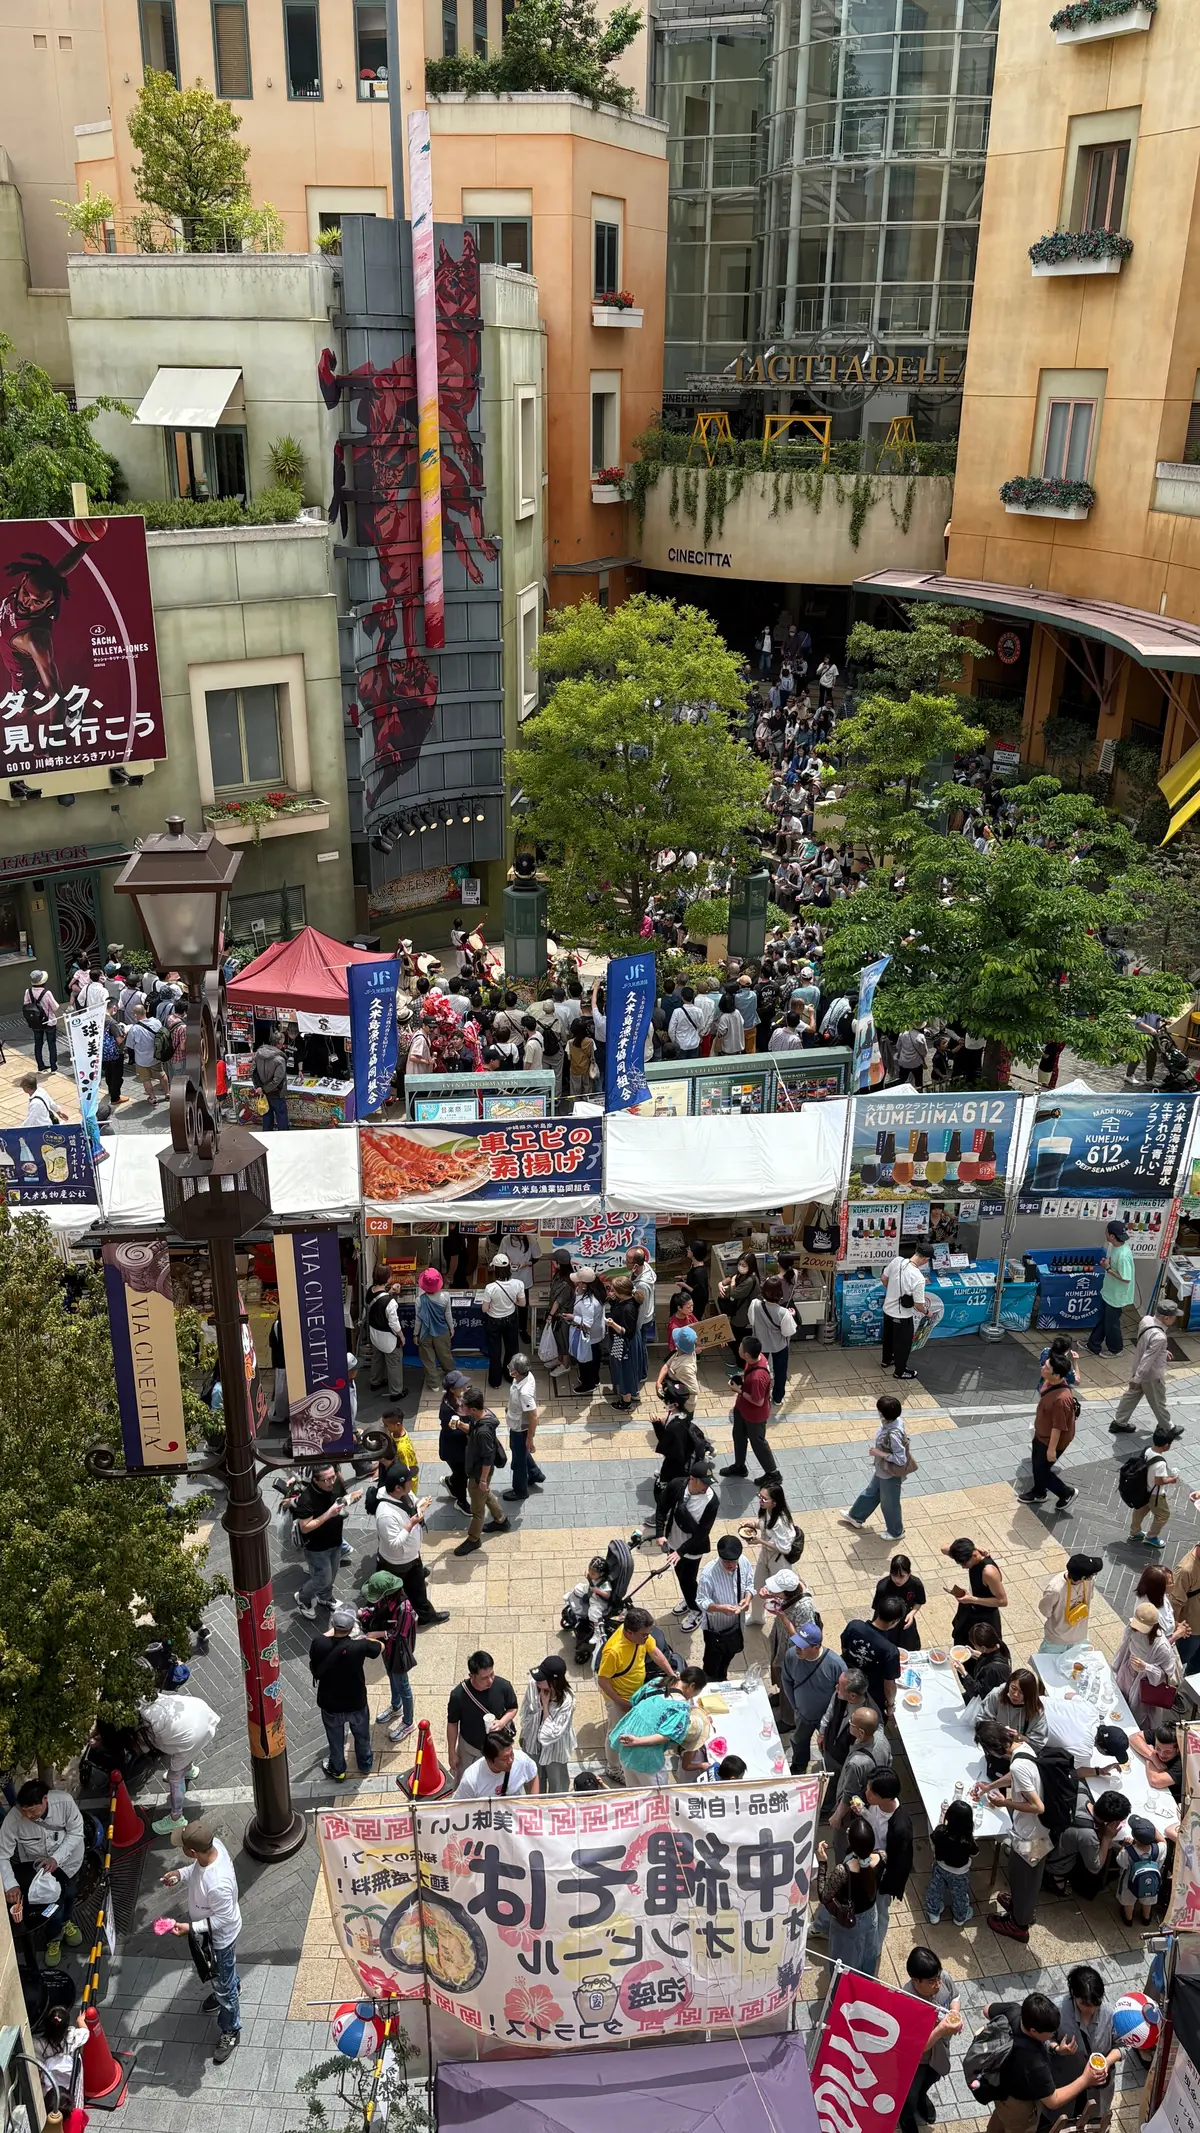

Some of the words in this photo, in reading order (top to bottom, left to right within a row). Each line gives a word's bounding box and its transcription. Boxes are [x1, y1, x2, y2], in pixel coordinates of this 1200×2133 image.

[91, 635, 117, 646] SACHA
[92, 643, 149, 656] KILLEYA-JONES
[4, 712, 156, 755] 見に行こう
[6, 763, 19, 773] GO
[19, 761, 31, 771] TO
[35, 748, 134, 769] 川崎市とどろきアリーナ
[0, 845, 88, 870] RMATION
[367, 970, 391, 987] JF
[625, 964, 645, 981] JF
[367, 997, 384, 1105] 久米島漁業協同組合
[615, 990, 638, 1102] 久米島漁業協同組合
[466, 1080, 520, 1088] INFORMATION
[441, 1105, 462, 1114] 音楽祭
[864, 1109, 959, 1127] KUMEJIMA
[962, 1100, 1005, 1124] 612
[866, 1102, 964, 1112] 久米島のクラフトビール
[1092, 1108, 1114, 1118] MADE
[1115, 1108, 1134, 1118] WITH
[478, 1126, 592, 1154] 車エビの
[1085, 1134, 1130, 1144] KUMEJIMA
[1133, 1102, 1160, 1175] クラフトビール
[1147, 1102, 1174, 1176] 生まれの「青い」
[1158, 1102, 1187, 1186] 久米島海洋深層水
[1086, 1144, 1122, 1164] 612
[488, 1146, 585, 1181] 素揚げ
[1075, 1159, 1091, 1173] DEEP
[1091, 1166, 1105, 1174] SEA
[1105, 1159, 1131, 1173] WATER
[881, 1168, 892, 1177] 612
[23, 1189, 87, 1200] 久米島物産公社
[512, 1183, 591, 1195] 久米島漁業協同組合
[884, 1205, 898, 1213] 612
[1152, 1200, 1166, 1208] 612
[369, 1221, 388, 1231] C28
[577, 1225, 636, 1257] 素揚げ
[300, 1237, 320, 1276] VIA
[802, 1256, 834, 1268] 2000円
[953, 1288, 987, 1296] KUMEJIMA
[966, 1295, 987, 1306] 612
[1068, 1297, 1092, 1313] 612
[130, 1299, 151, 1336] VIA
